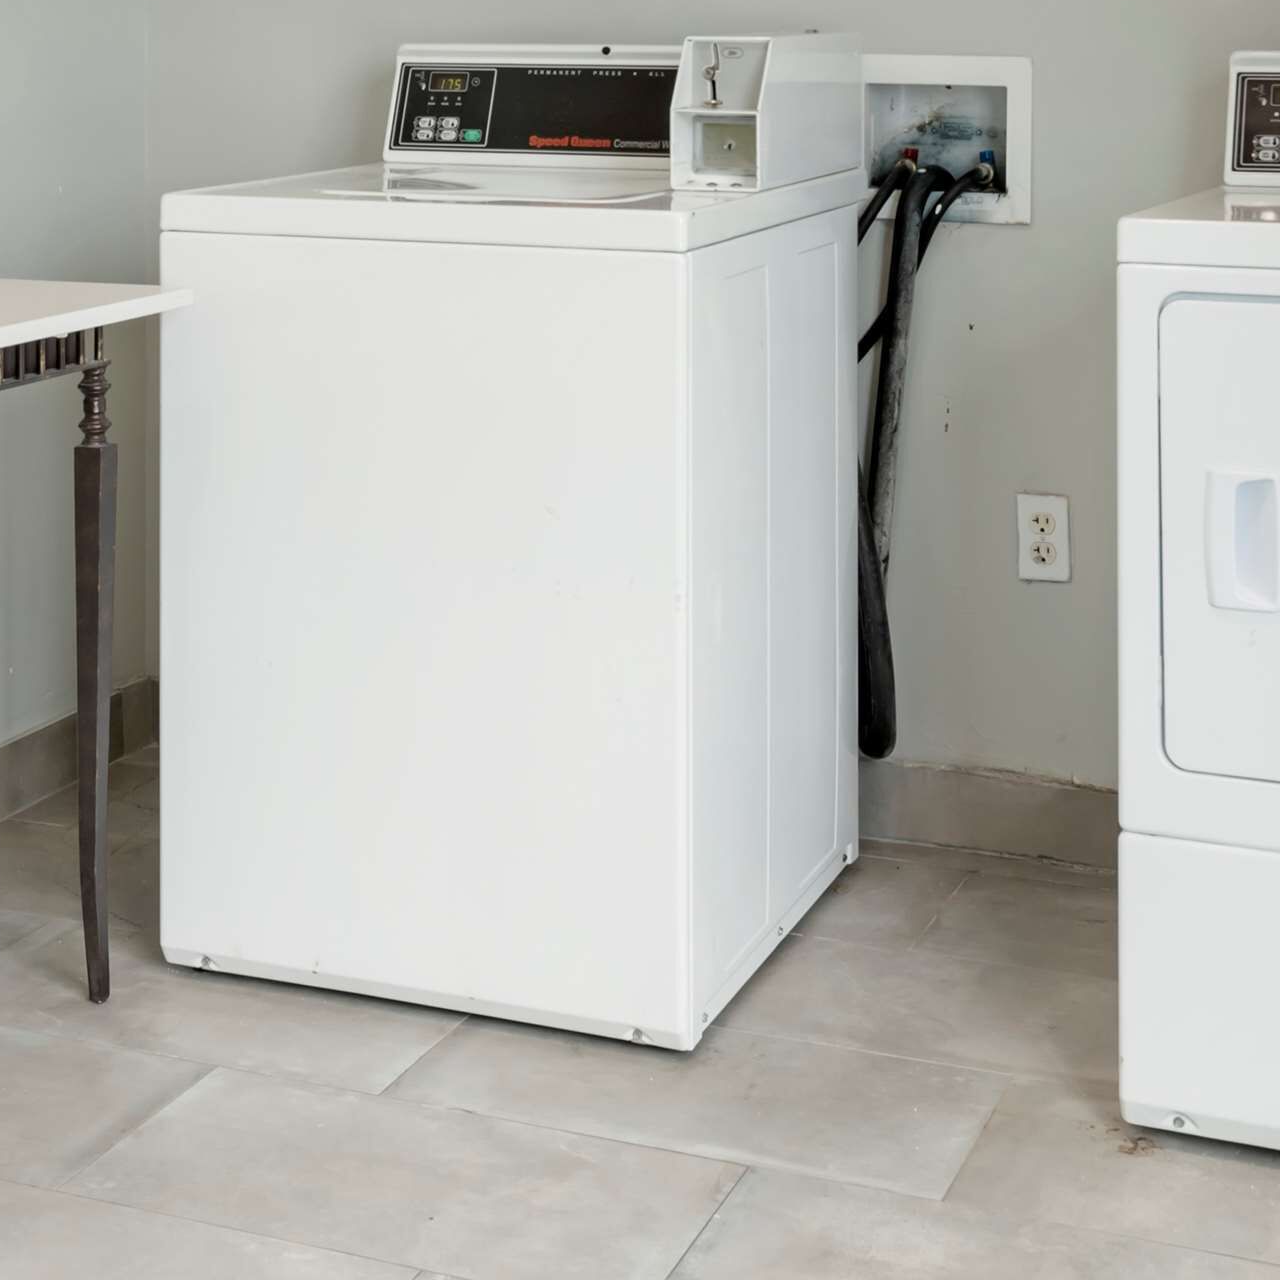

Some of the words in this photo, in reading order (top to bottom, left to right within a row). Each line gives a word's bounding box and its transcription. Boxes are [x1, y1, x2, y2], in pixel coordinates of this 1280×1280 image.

[440, 78, 462, 90] 175
[528, 135, 569, 148] Speed
[570, 135, 612, 148] Queen
[613, 138, 661, 149] Commercial
